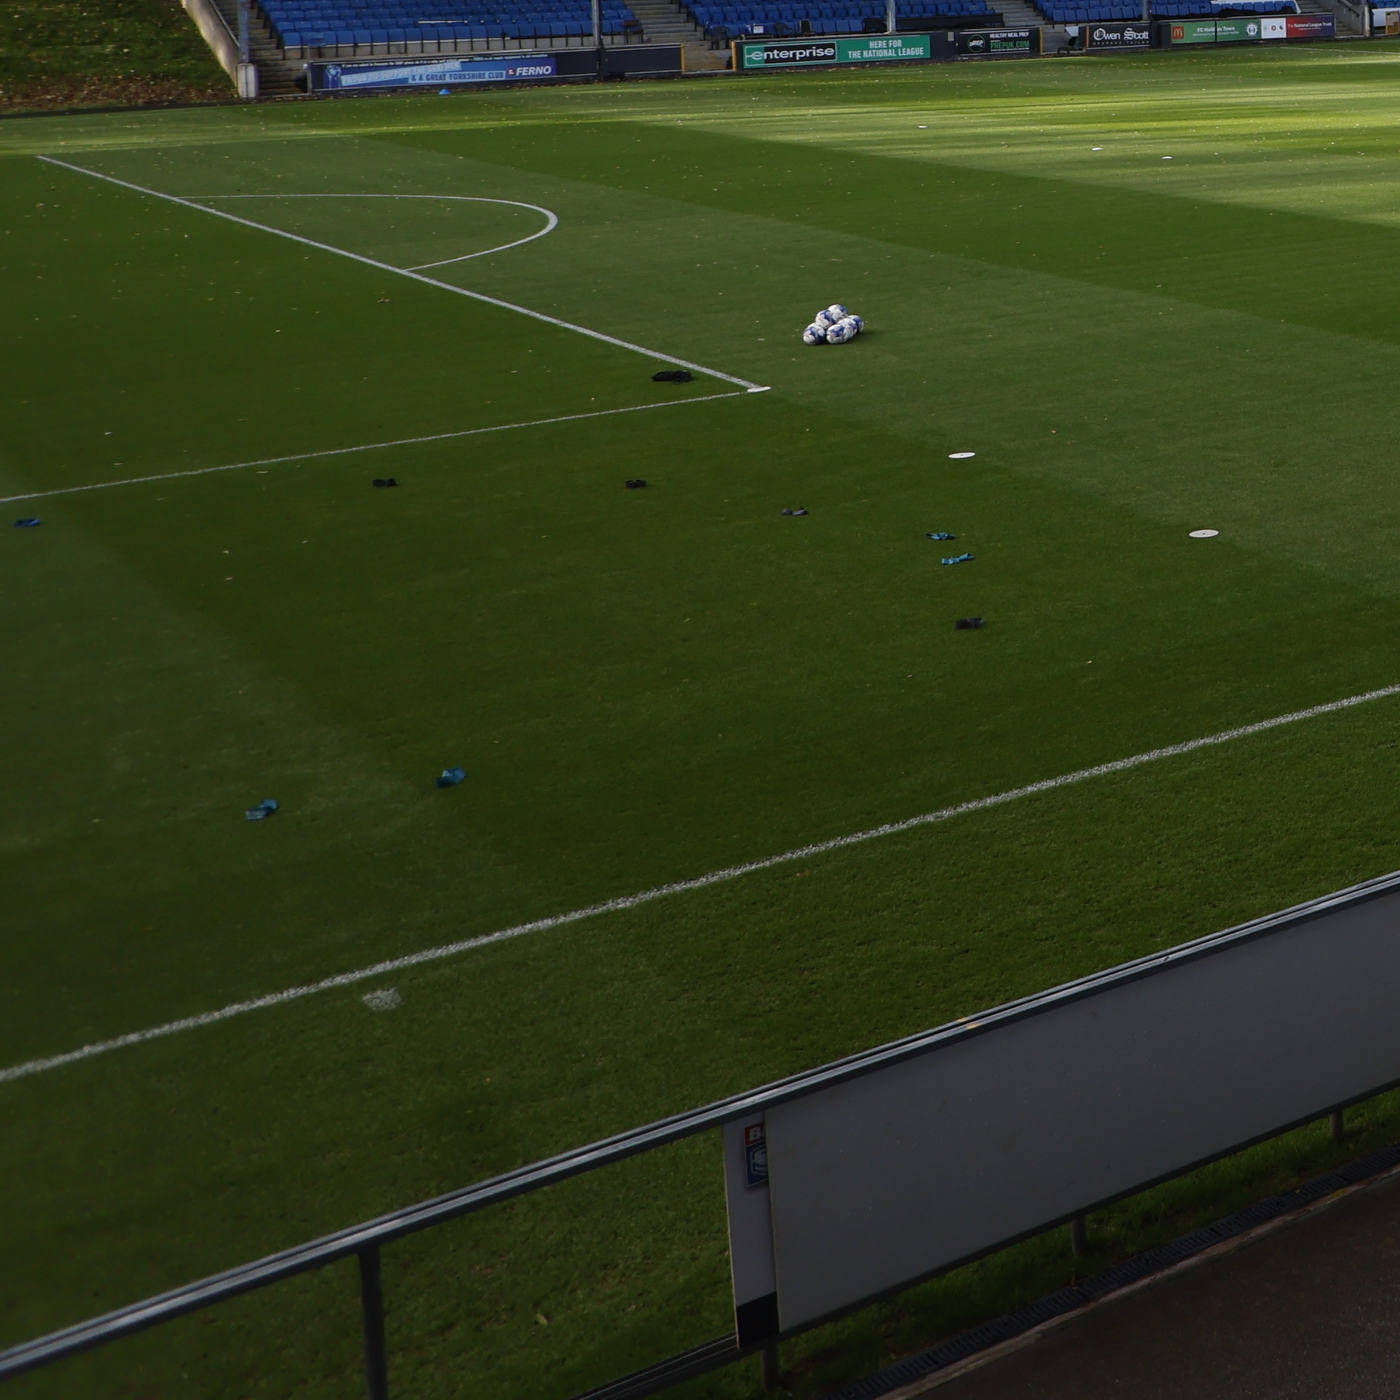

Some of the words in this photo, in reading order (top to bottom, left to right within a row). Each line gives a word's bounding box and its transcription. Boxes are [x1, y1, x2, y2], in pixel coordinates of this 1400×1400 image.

[1093, 28, 1121, 41] Owen
[1123, 27, 1149, 40] Scott
[869, 40, 887, 49] HERE
[888, 39, 902, 48] FOR
[749, 47, 835, 61] enterprise
[848, 50, 862, 59] THE
[863, 49, 896, 58] NATIONAL
[898, 48, 924, 57] LEAGUE
[516, 66, 552, 76] FERNO
